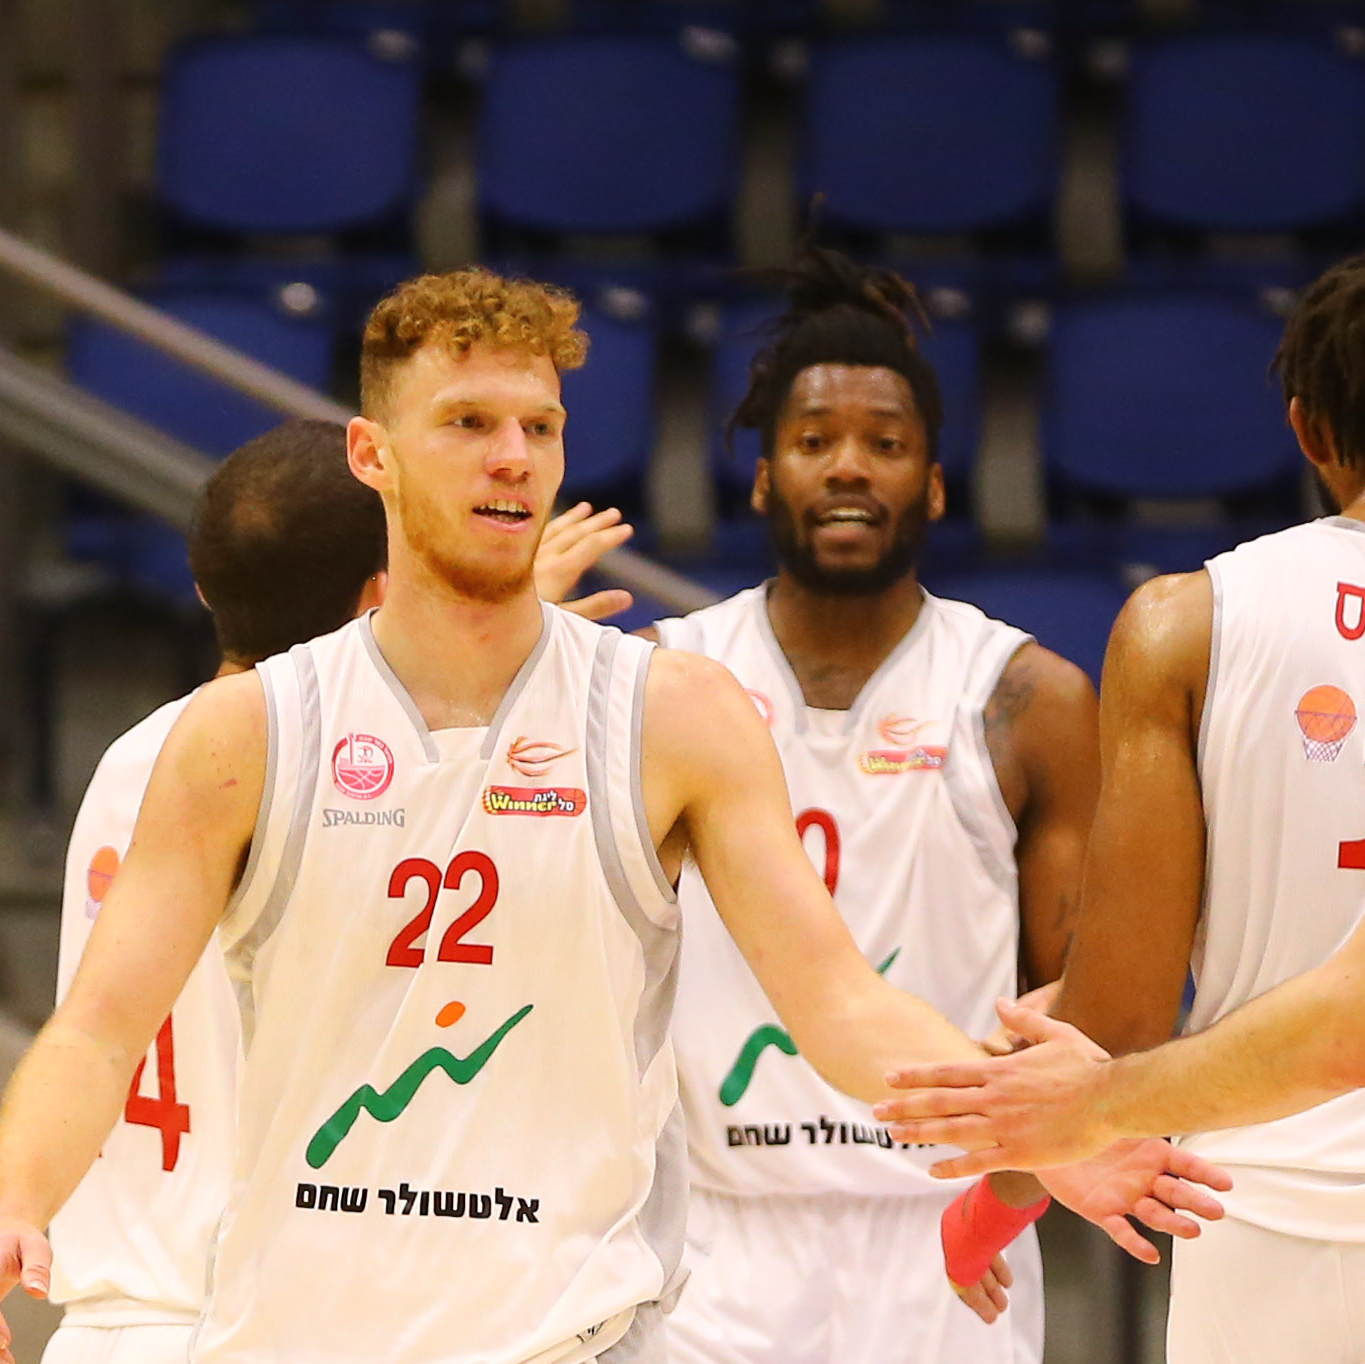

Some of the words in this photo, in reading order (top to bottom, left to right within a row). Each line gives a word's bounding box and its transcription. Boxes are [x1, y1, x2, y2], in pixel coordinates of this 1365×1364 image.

[322, 808, 405, 828] SPALDING
[490, 793, 558, 811] Winner
[386, 850, 499, 968] 22
[727, 1122, 792, 1147] שחם
[801, 1115, 935, 1149] טשולר
[295, 1182, 369, 1214] שחם
[377, 1183, 540, 1224] אלטשולר
